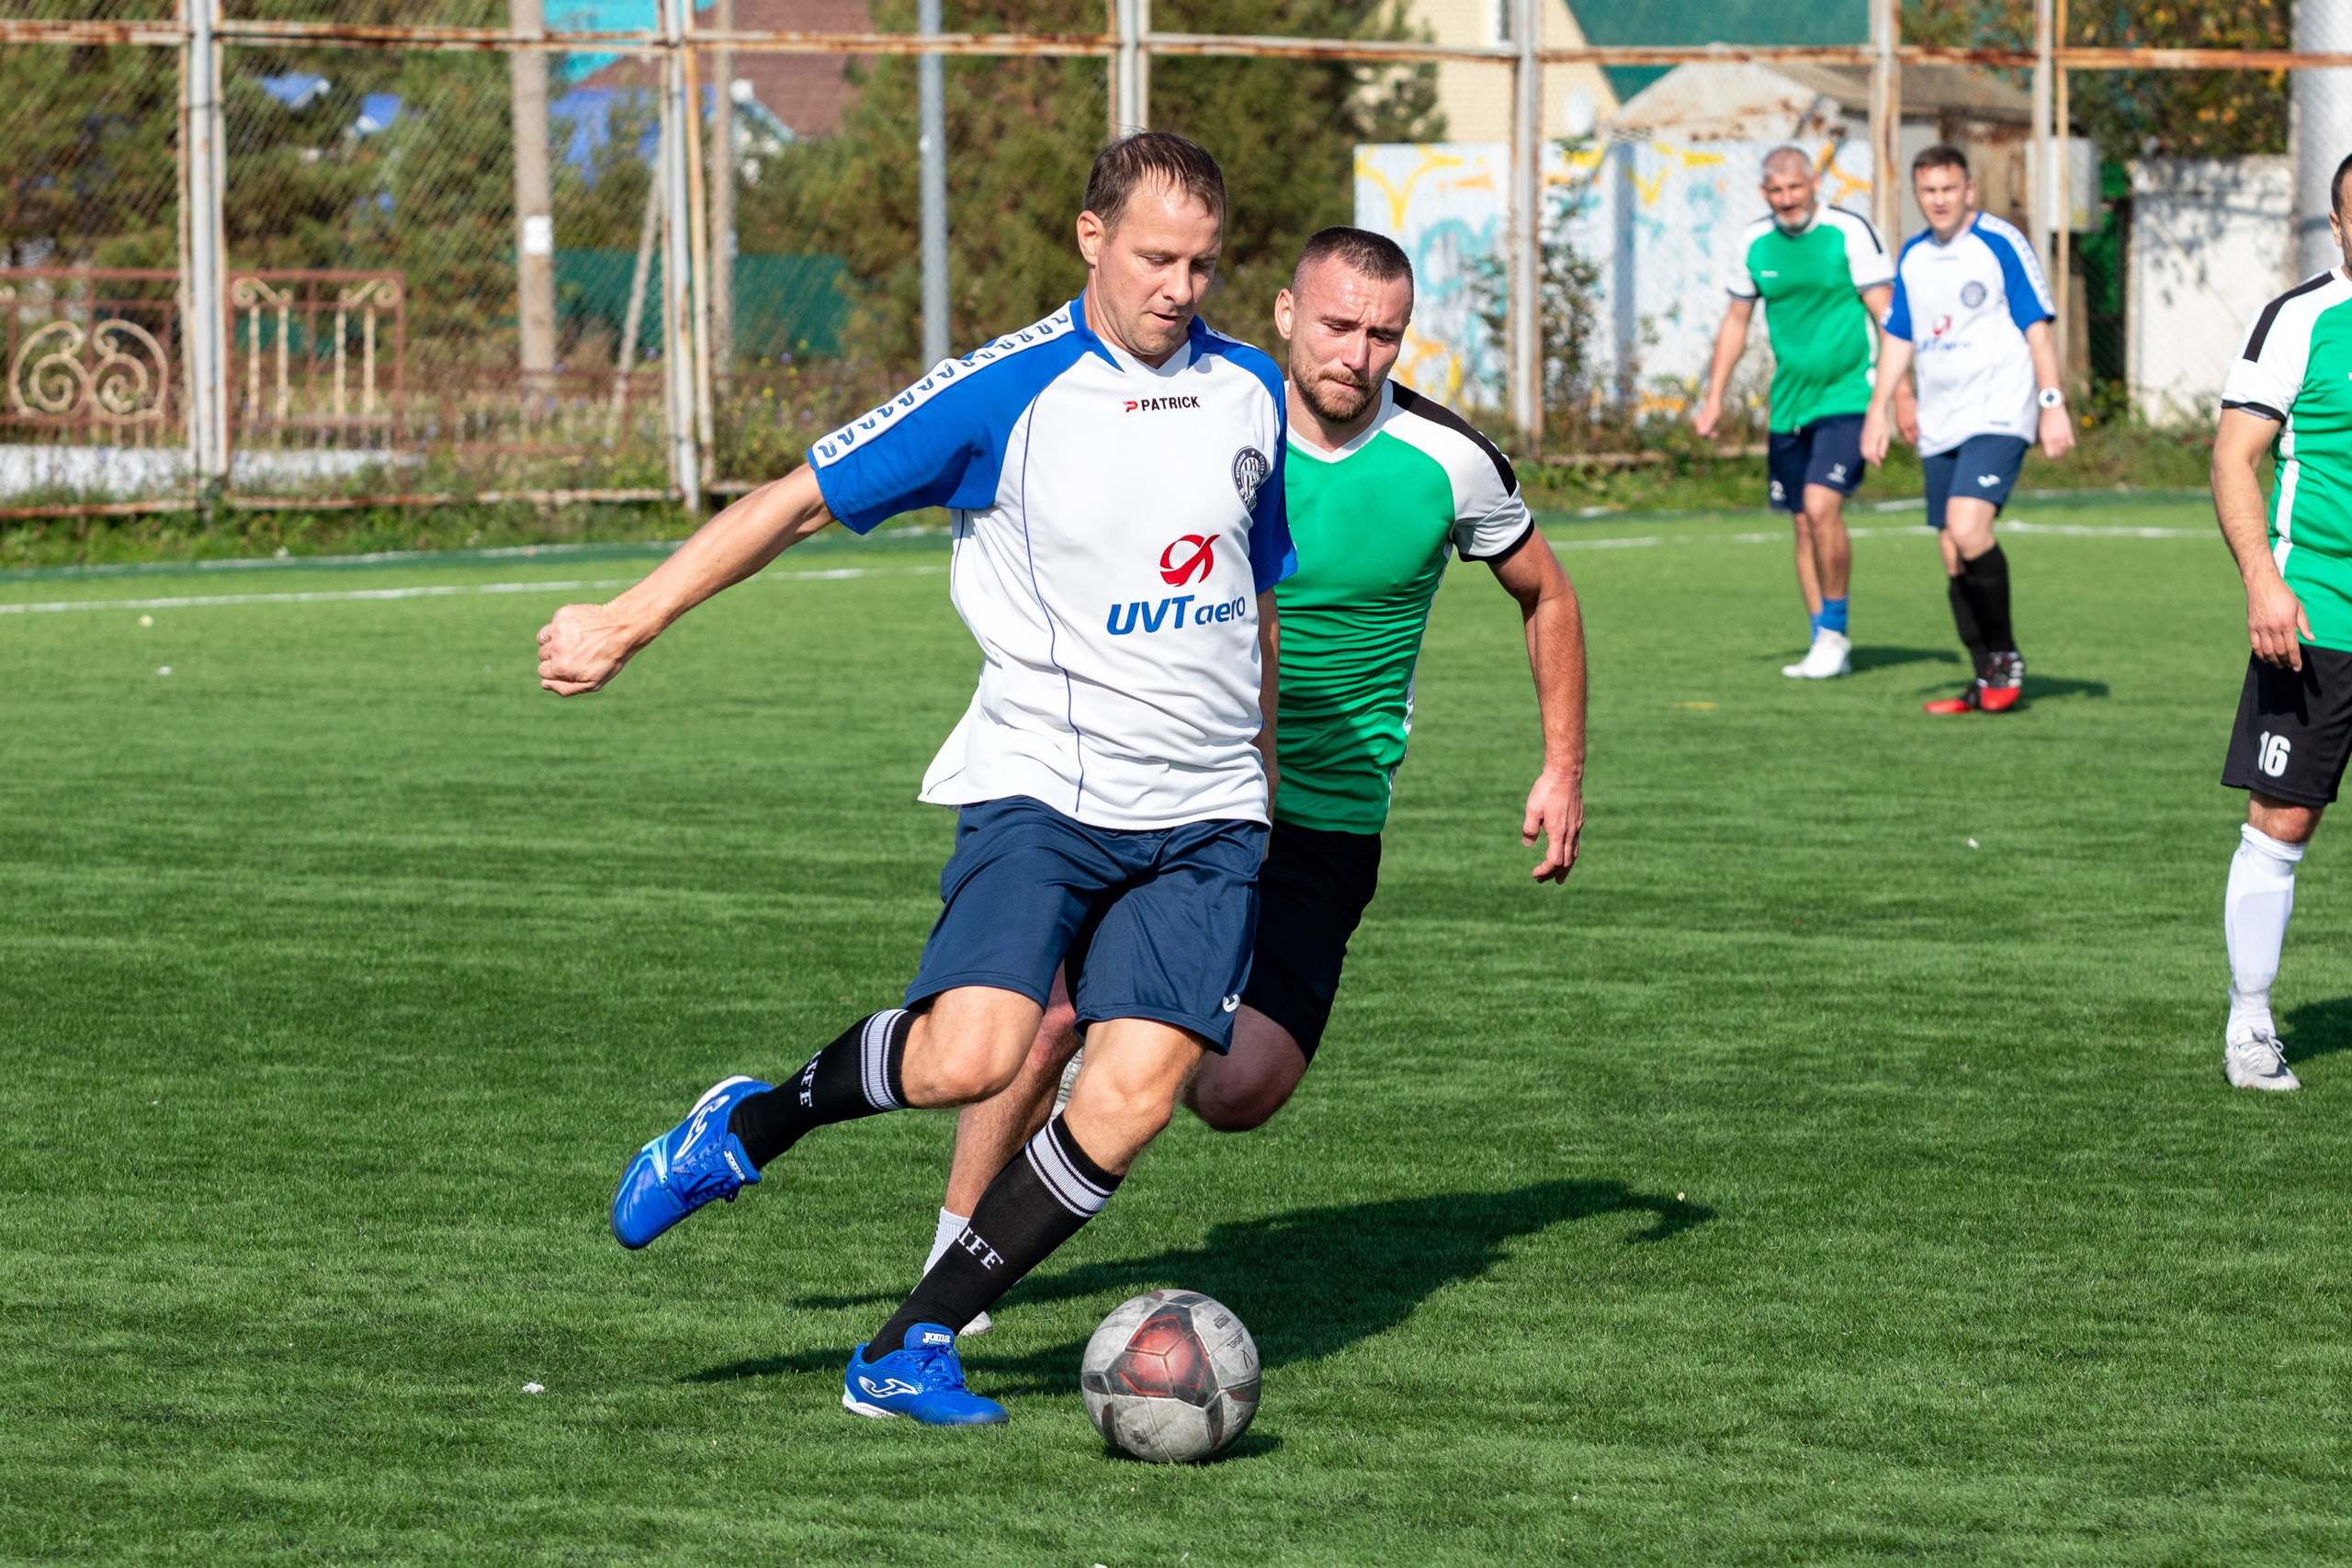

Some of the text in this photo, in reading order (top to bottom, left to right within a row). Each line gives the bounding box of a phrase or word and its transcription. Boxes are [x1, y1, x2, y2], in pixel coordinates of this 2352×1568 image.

[1140, 396, 1201, 412] PATRICK
[1106, 594, 1246, 636] UVT aero
[2257, 730, 2291, 778] 16
[956, 1225, 1004, 1270] IFE
